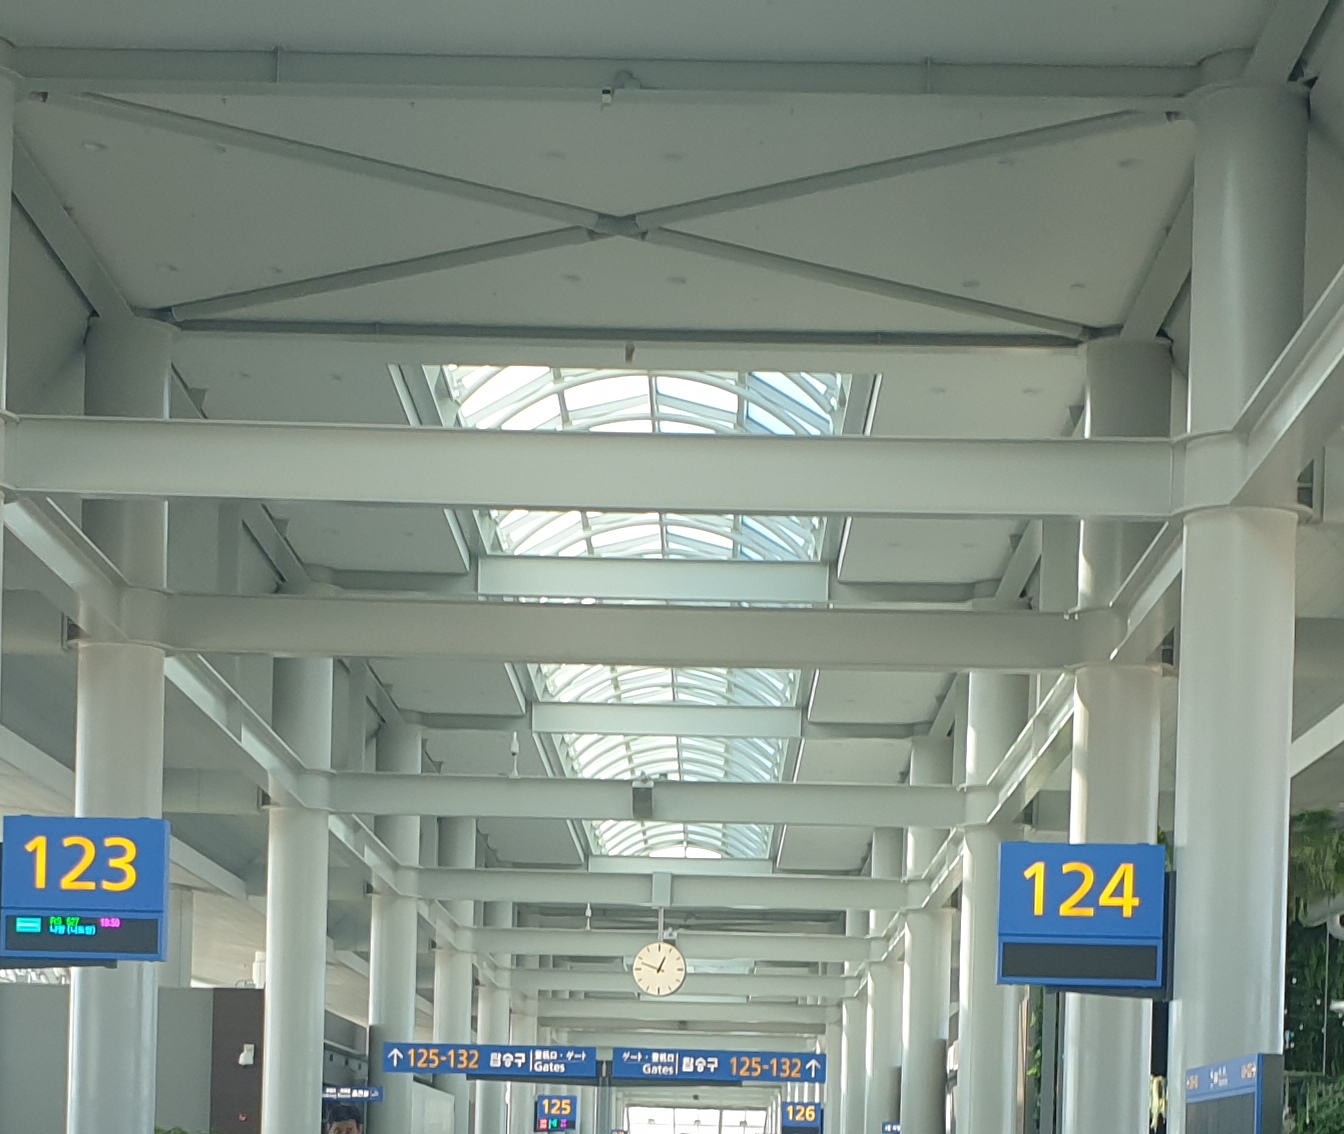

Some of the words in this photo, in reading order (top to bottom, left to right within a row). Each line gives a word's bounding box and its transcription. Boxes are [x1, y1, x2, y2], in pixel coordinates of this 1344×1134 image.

[25, 835, 138, 892] 123
[1023, 861, 1140, 918] 124
[408, 1048, 480, 1069] 125-132
[534, 1061, 566, 1073] Gates
[730, 1056, 802, 1078] 125-132
[642, 1063, 674, 1076] Gates
[542, 1098, 572, 1115] 125
[786, 1105, 816, 1121] 126
